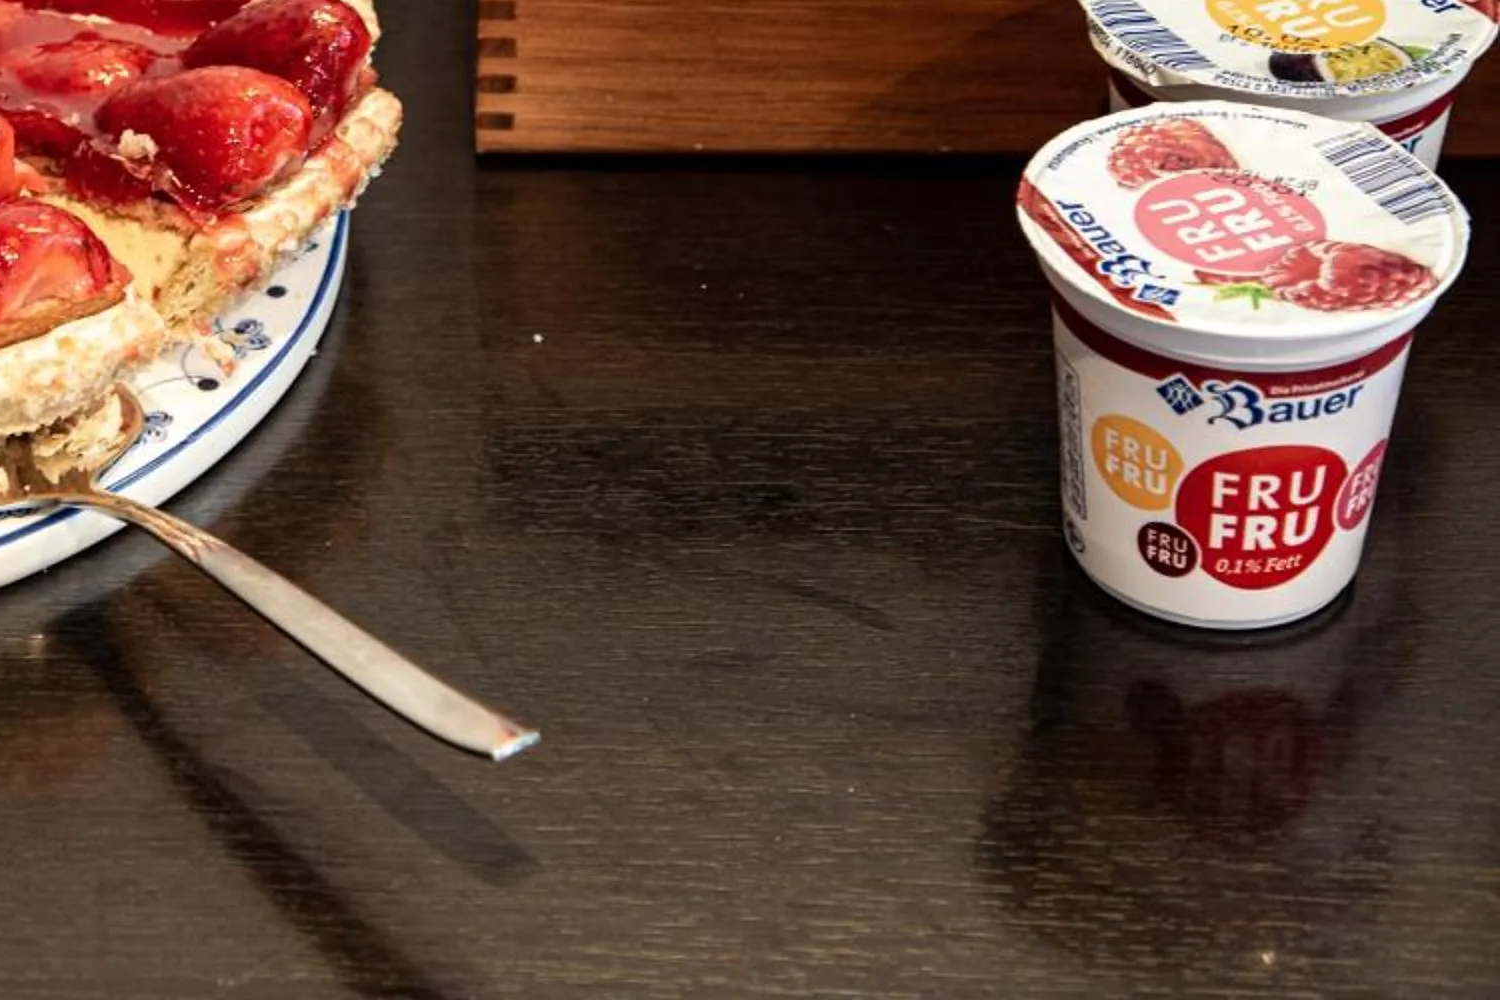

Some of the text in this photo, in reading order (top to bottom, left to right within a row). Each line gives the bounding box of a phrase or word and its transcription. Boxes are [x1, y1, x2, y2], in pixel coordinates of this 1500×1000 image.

[1149, 199, 1247, 263] FRU
[1192, 187, 1293, 251] FRU
[1056, 199, 1167, 286] Bauer
[1206, 381, 1365, 431] Bauer
[1105, 428, 1168, 470] FRU
[1105, 453, 1168, 496] FRU
[1212, 465, 1327, 511] FRU
[1147, 528, 1188, 553] FRU
[1208, 506, 1320, 551] FRU
[1147, 545, 1188, 570] FRU
[1215, 554, 1304, 576] 0,1% Fett
